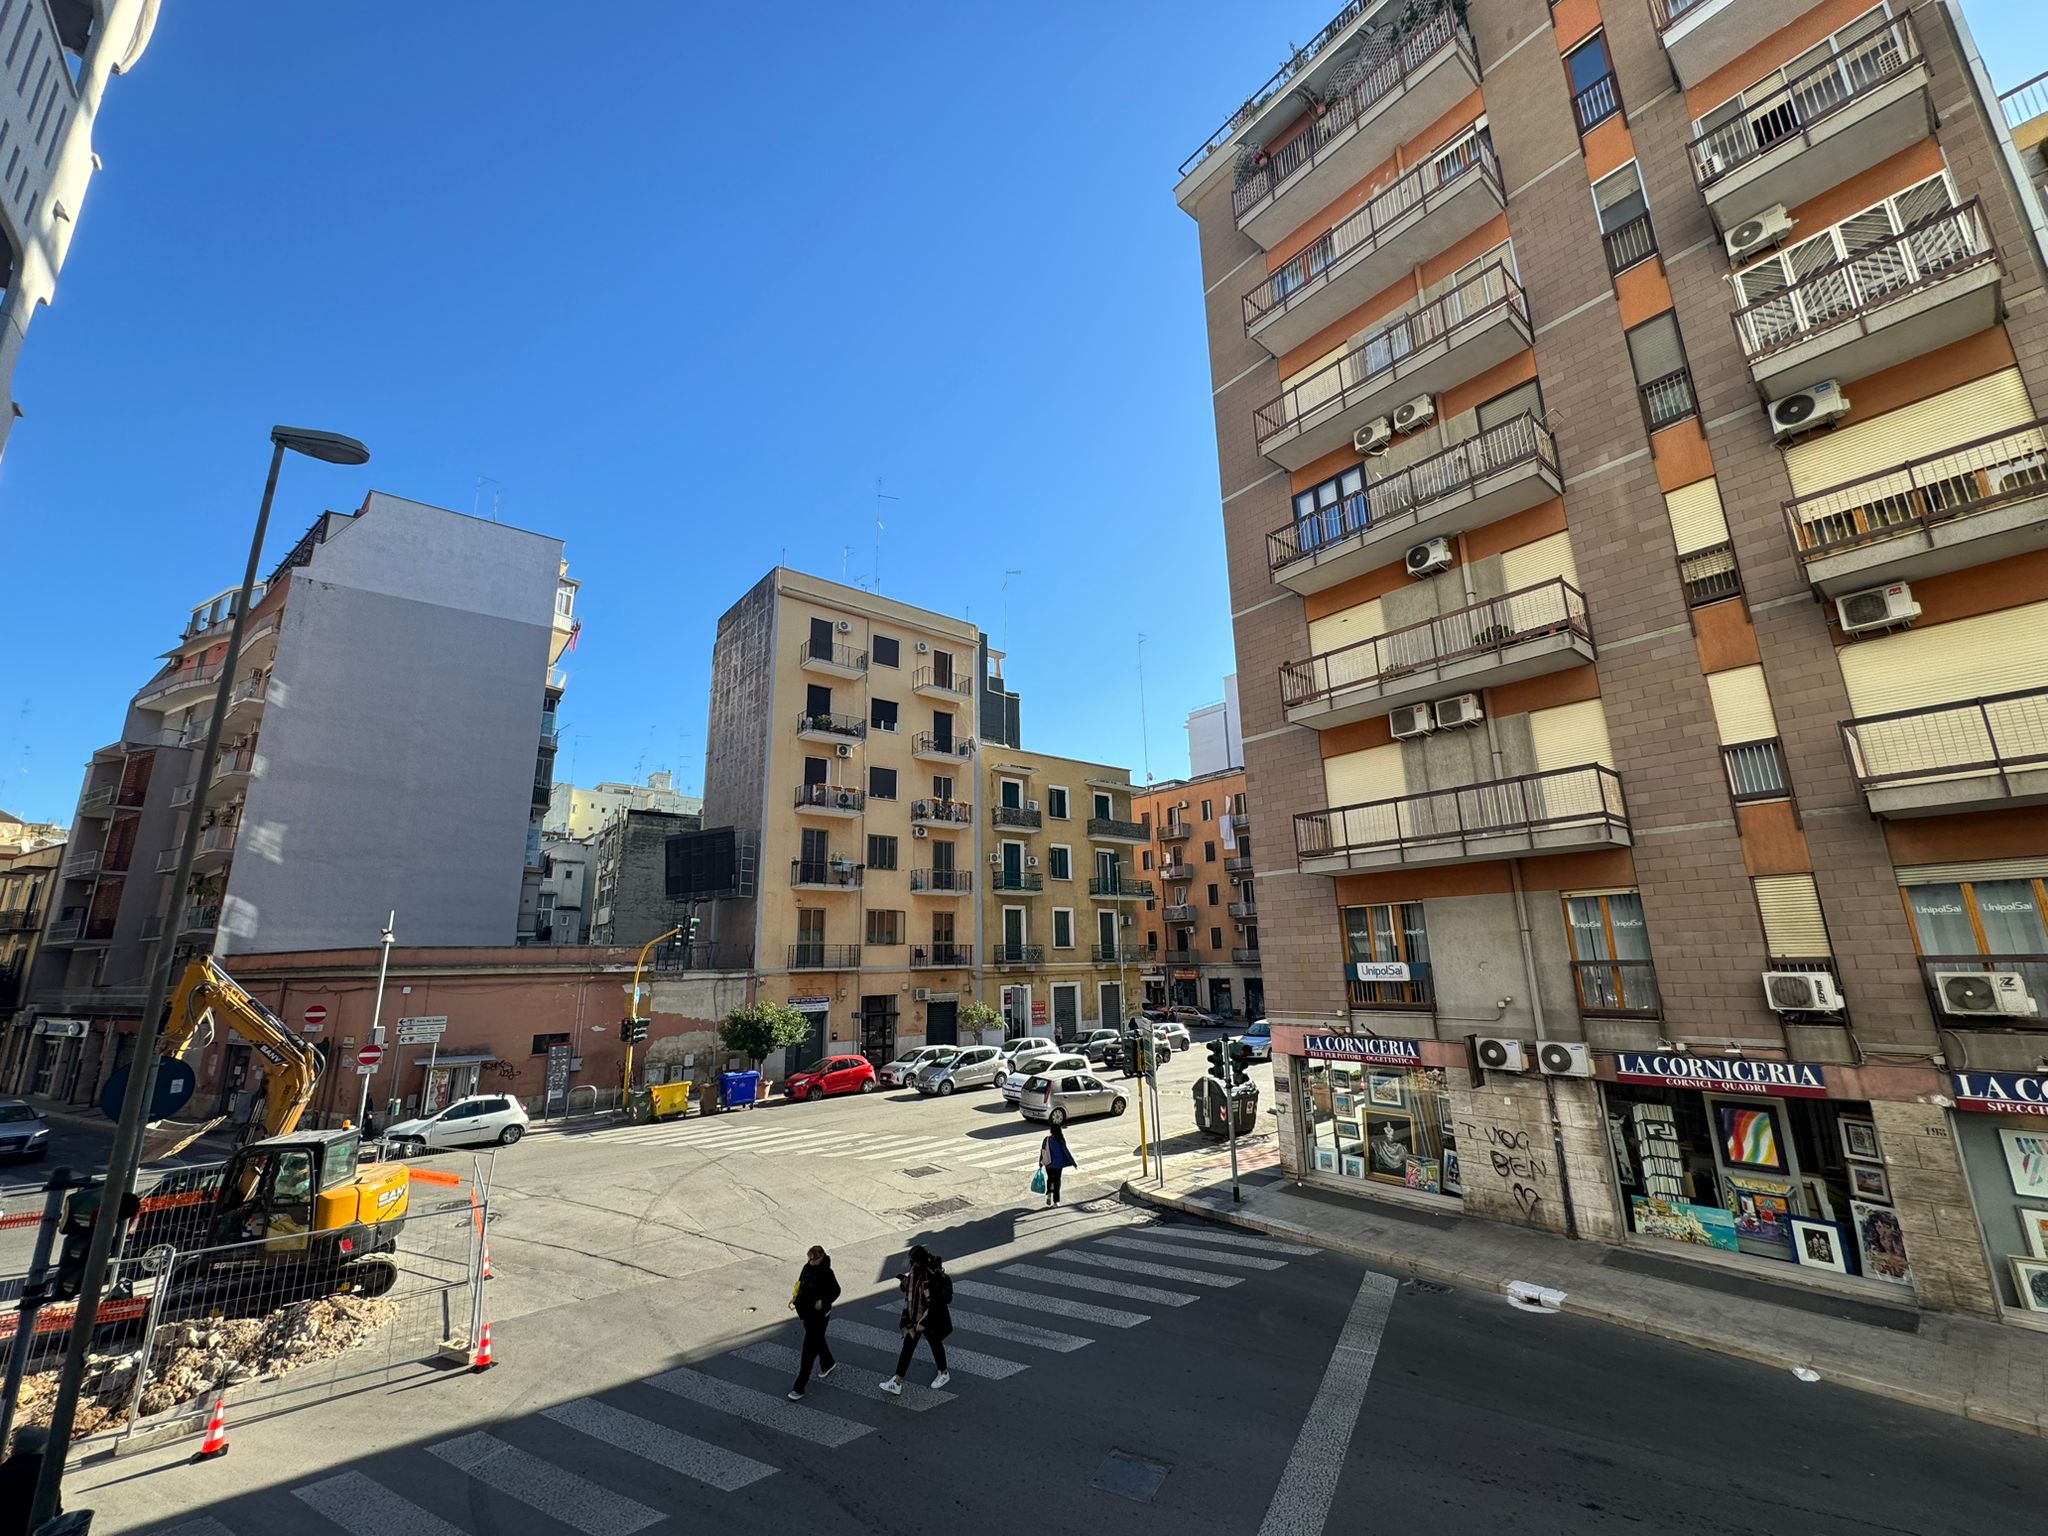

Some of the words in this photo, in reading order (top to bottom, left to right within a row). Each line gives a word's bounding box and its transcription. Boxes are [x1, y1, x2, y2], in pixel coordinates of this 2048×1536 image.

[1915, 904, 1962, 915] UnipolSai
[1983, 901, 2033, 913] UnipolSai
[1361, 965, 1403, 978] UnipolSai
[1306, 1035, 1323, 1050] LA
[1325, 1036, 1417, 1057] CORNICERIA
[1366, 1055, 1414, 1065] OGGETTISTICA
[1618, 1054, 1649, 1073] LA
[1653, 1056, 1819, 1086] CORNICERIA
[1666, 1077, 1712, 1089] CORNICI
[1721, 1082, 1767, 1093] QUADRI
[1956, 1074, 2012, 1100] LA
